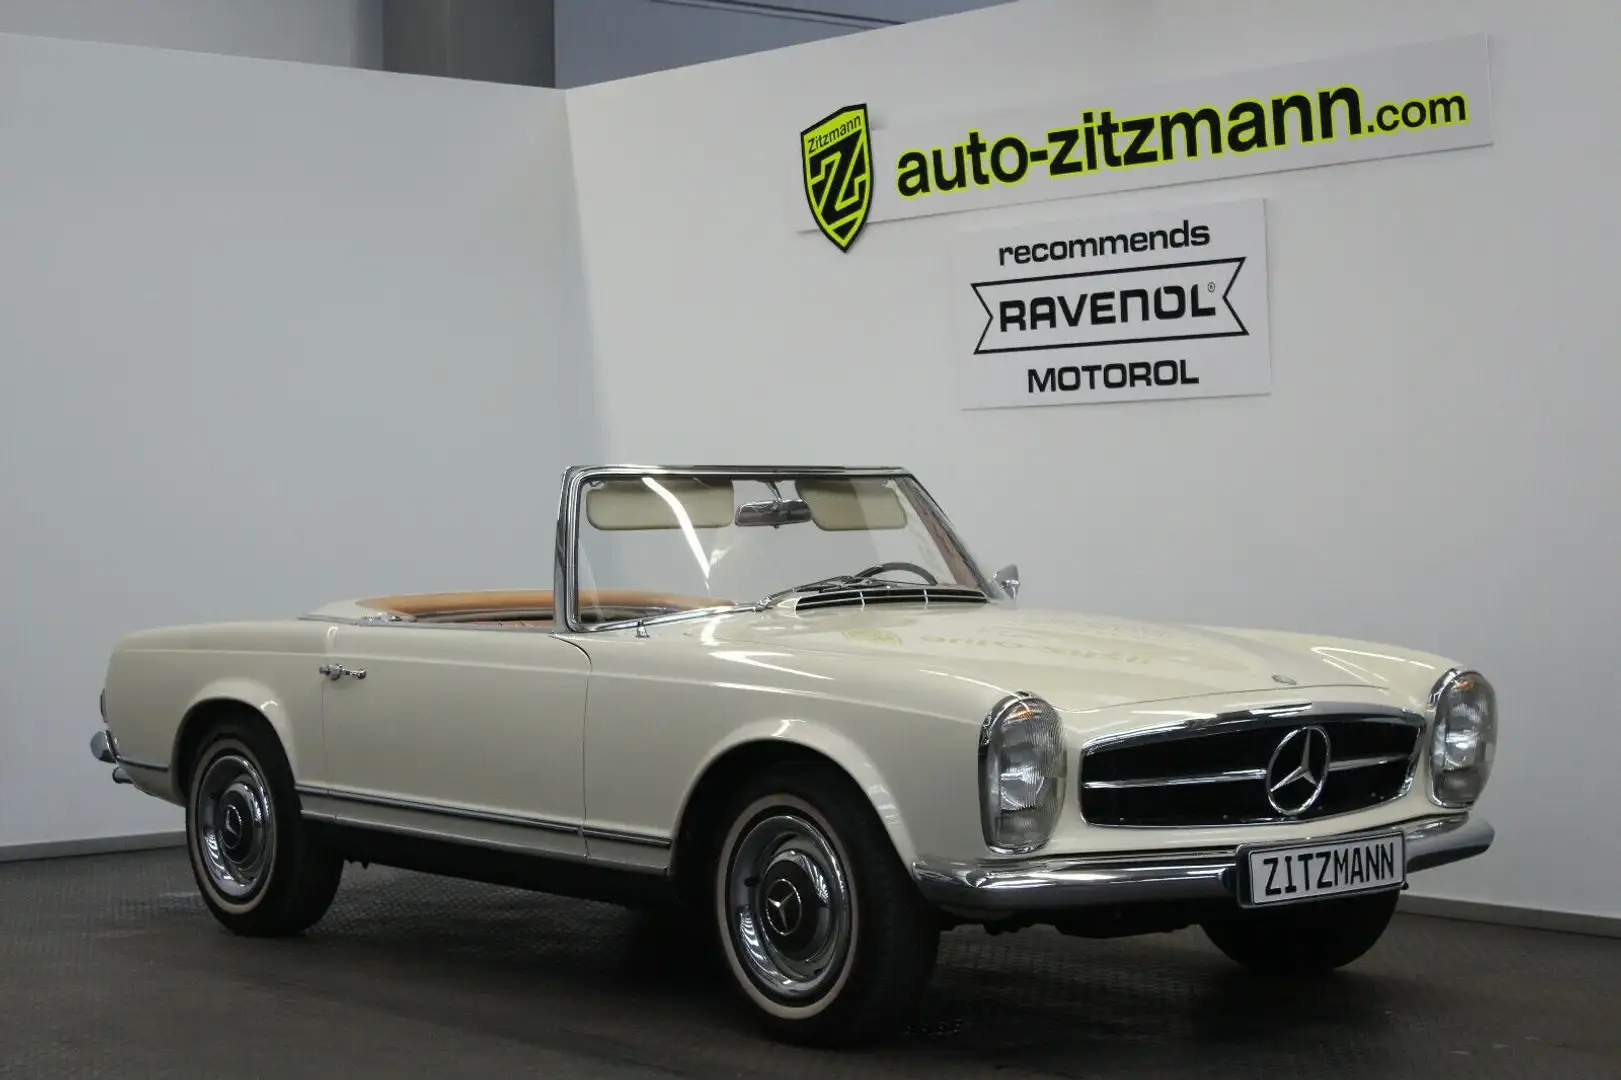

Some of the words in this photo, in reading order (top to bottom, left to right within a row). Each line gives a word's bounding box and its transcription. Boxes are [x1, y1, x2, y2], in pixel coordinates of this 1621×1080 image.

[807, 115, 861, 154] Zitzmann
[897, 84, 1467, 198] auto-zitzmann.com
[998, 219, 1210, 266] recommends
[1027, 358, 1199, 393] MOTOROL
[1263, 842, 1394, 896] ZITZMANN
